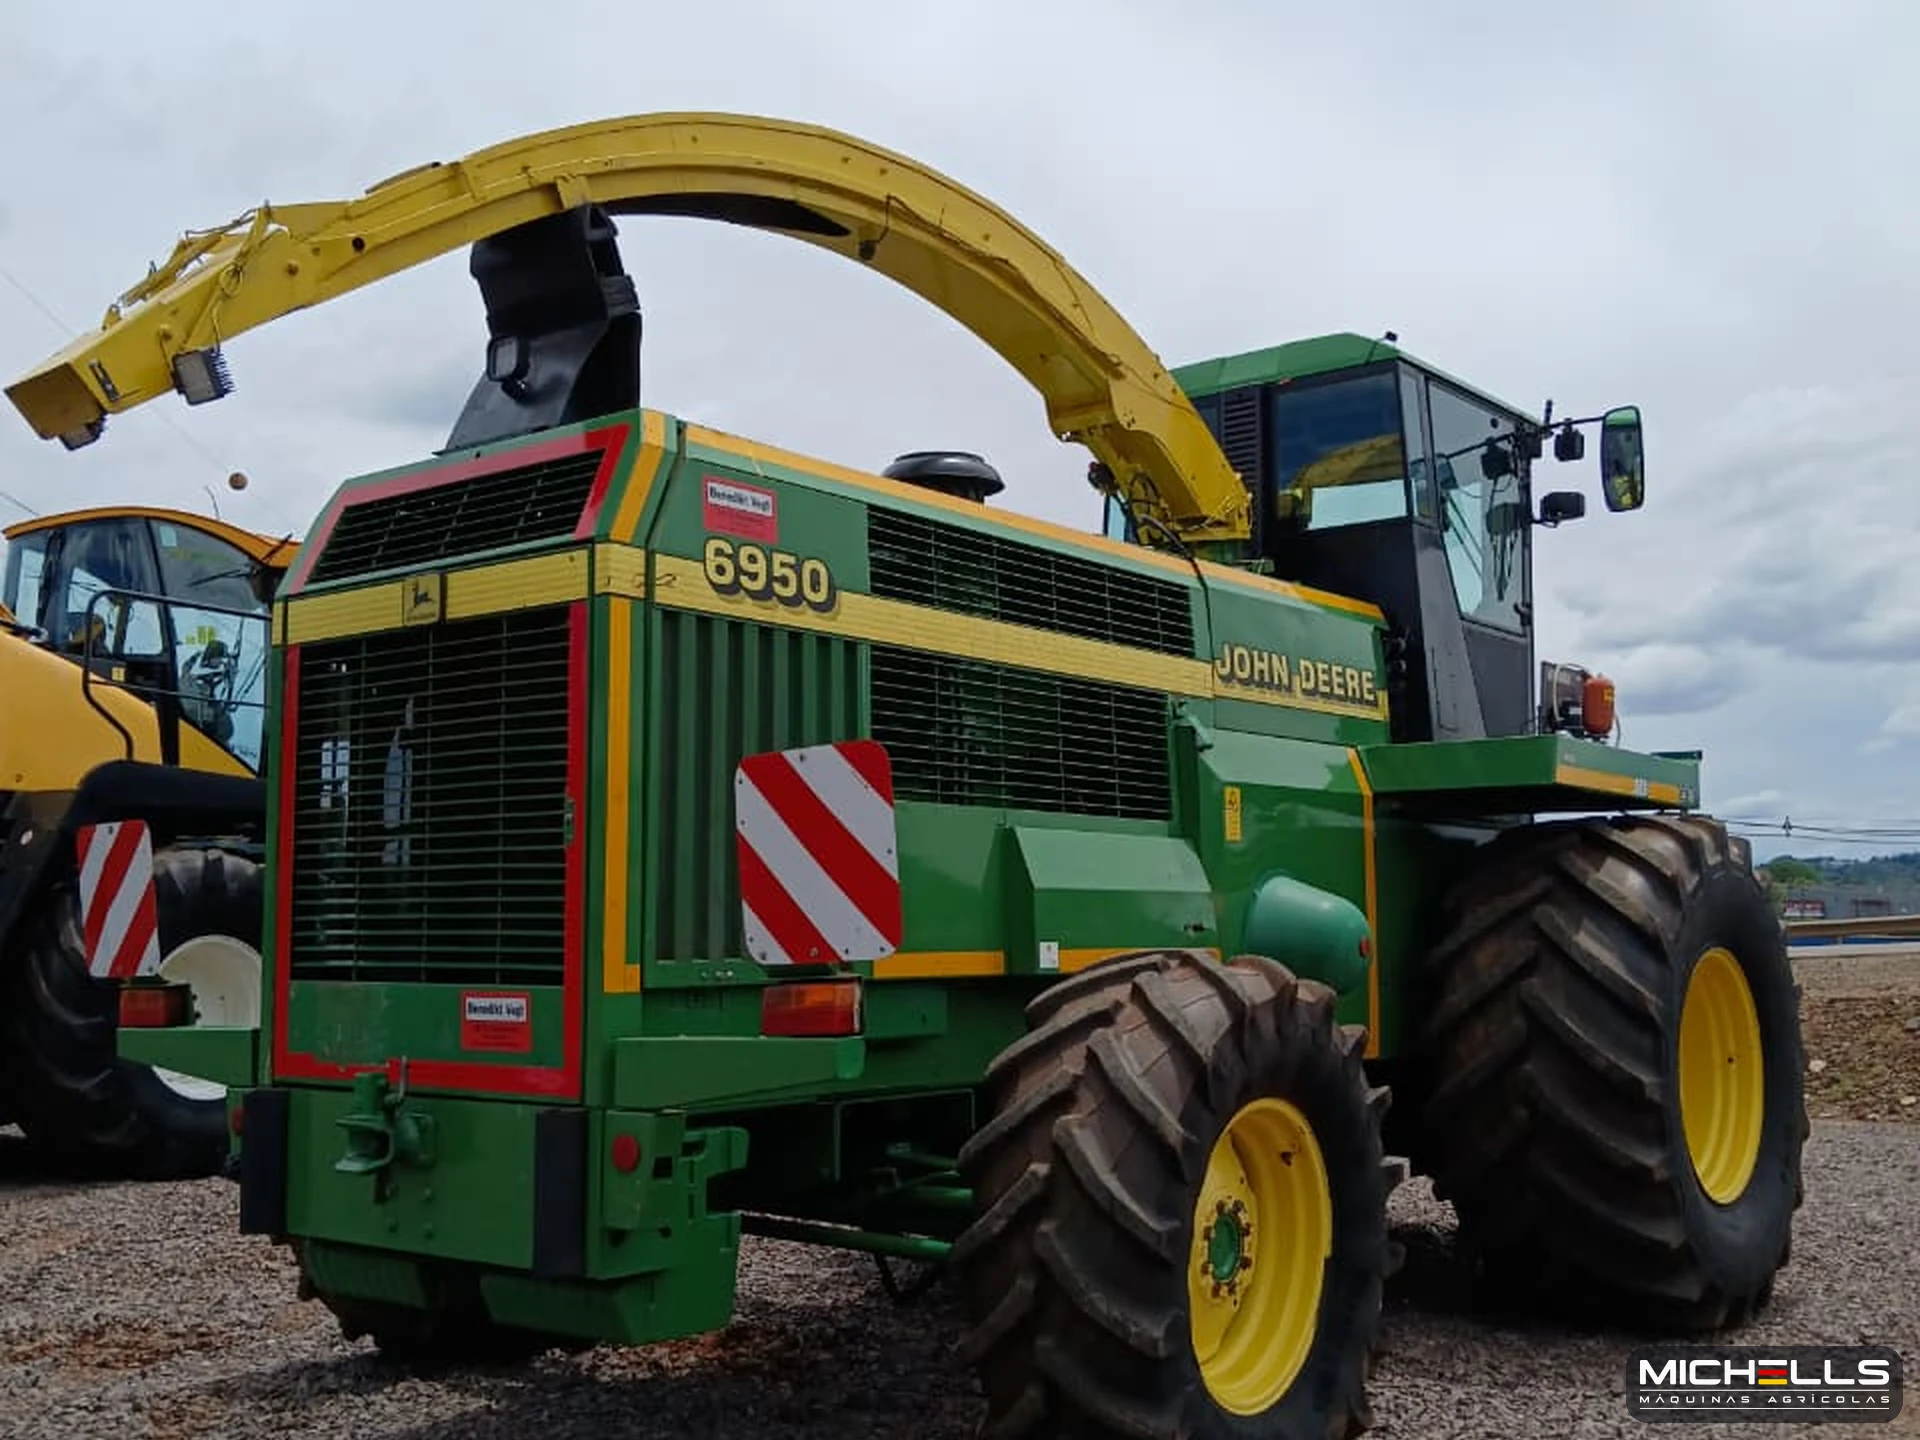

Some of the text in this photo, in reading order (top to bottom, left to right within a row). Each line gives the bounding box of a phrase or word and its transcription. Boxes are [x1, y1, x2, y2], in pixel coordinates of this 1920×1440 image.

[704, 537, 833, 608] 6950
[1215, 642, 1376, 702] JOHN DEERE
